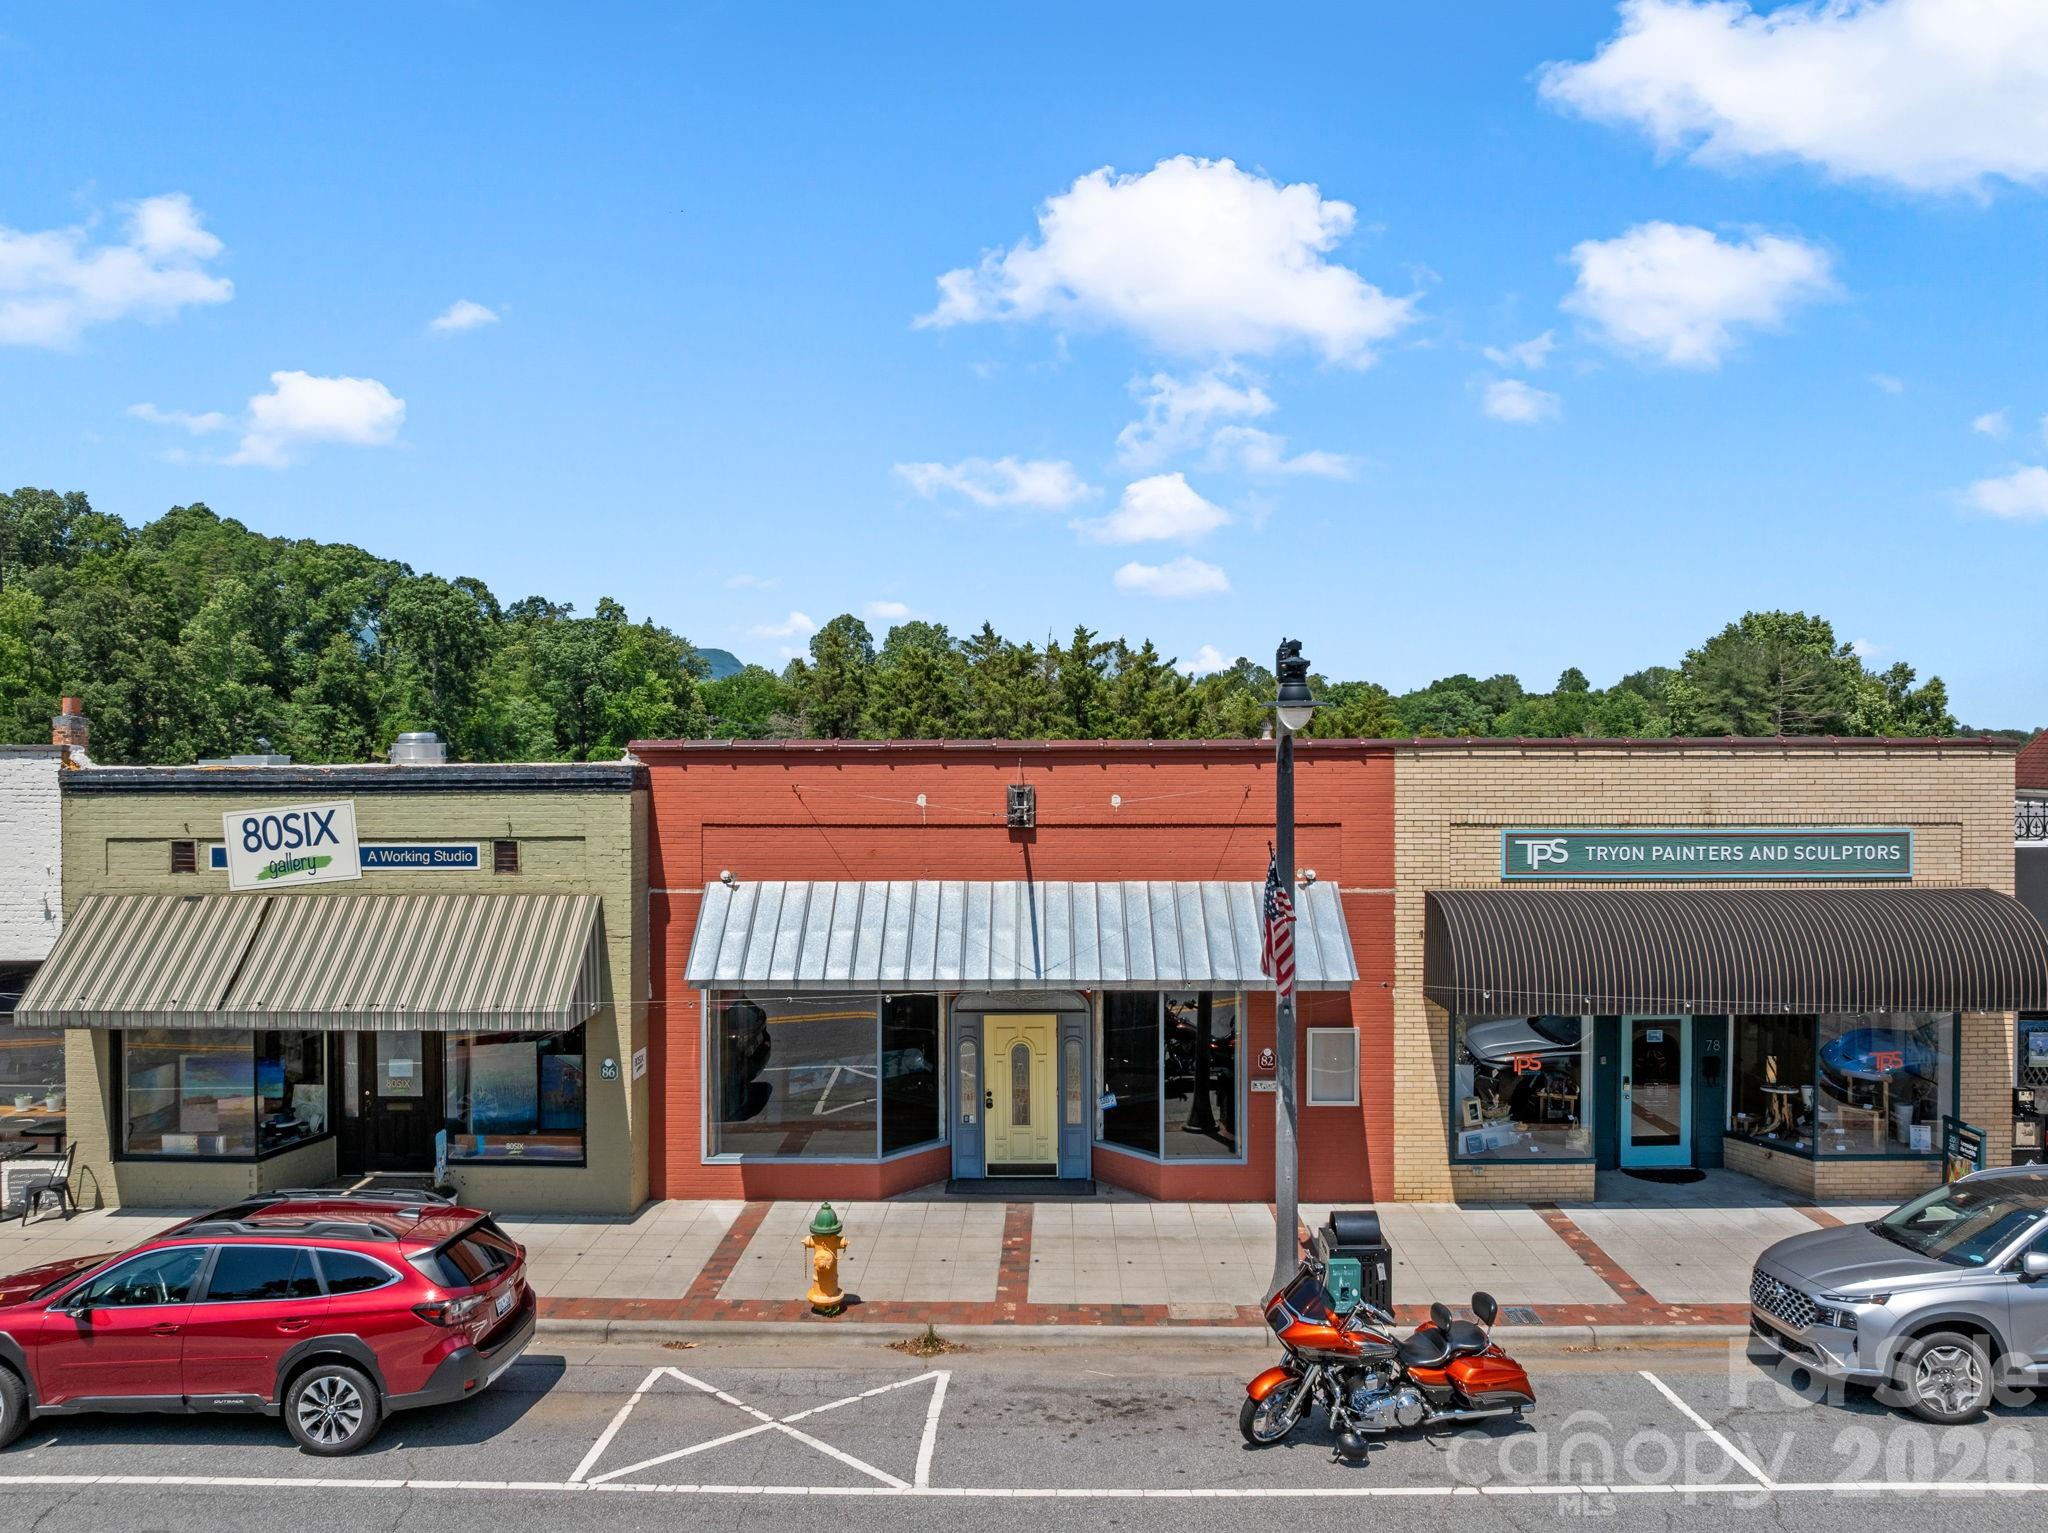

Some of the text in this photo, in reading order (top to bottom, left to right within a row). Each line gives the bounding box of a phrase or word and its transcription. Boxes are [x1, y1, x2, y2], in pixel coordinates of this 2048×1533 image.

[242, 809, 340, 853] 80SIX
[367, 850, 473, 865] A Working Studio
[1514, 838, 1569, 870] TPS
[1585, 845, 1901, 861] TRYON PAINTERS AND SCULPTORS
[269, 852, 317, 879] gallery
[1705, 1039, 1721, 1052] 78
[1260, 1055, 1274, 1067] 82
[1505, 1052, 1543, 1076] TPS
[1868, 1051, 1905, 1073] TPS
[602, 1066, 616, 1079] 86
